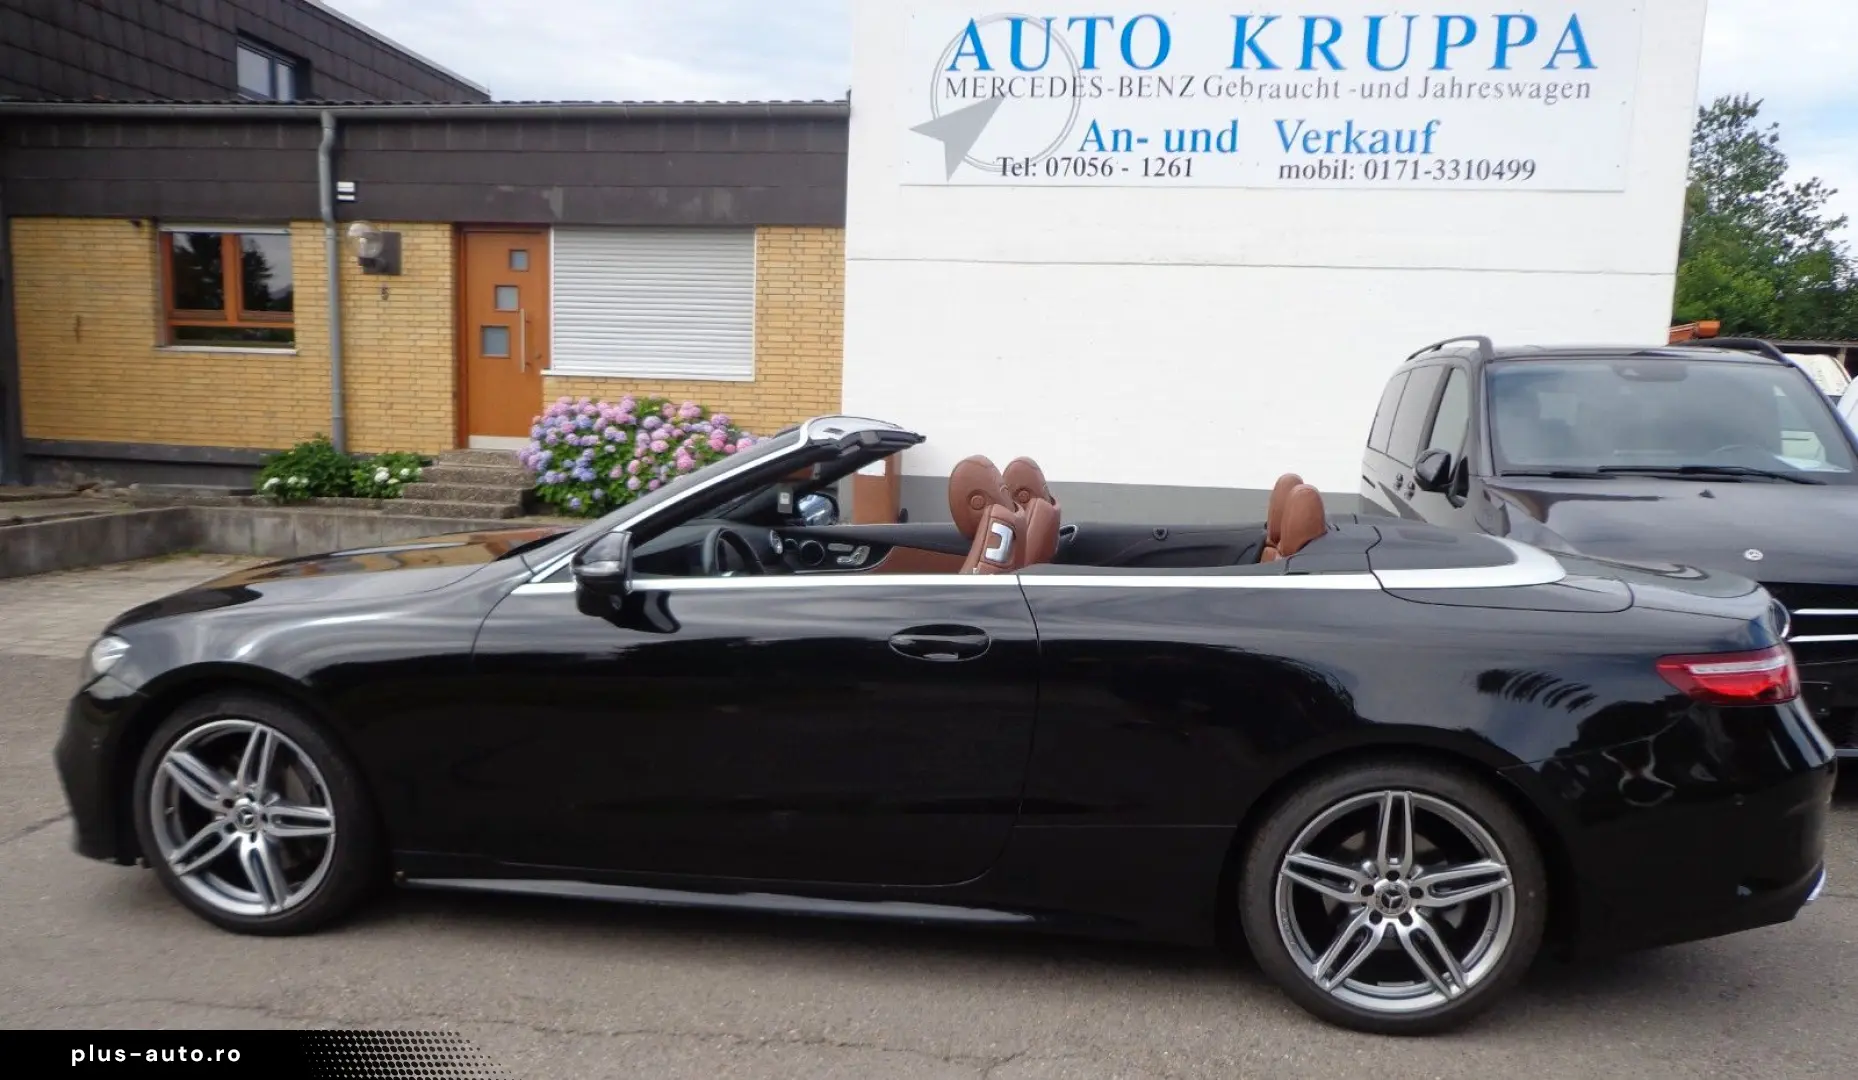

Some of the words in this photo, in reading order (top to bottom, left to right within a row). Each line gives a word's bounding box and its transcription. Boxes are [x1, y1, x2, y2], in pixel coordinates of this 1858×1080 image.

[946, 14, 1172, 71] AUTO
[1226, 13, 1599, 71] KRUPPA
[946, 75, 1196, 99] MERCEDES-BENZ
[1203, 75, 1341, 100] Gebraucht
[1349, 77, 1409, 99] -und
[1418, 76, 1592, 106] Jahreswagen
[1078, 118, 1149, 153] An-
[1163, 118, 1239, 153] und
[1274, 119, 1441, 154] Verkauf
[997, 156, 1038, 177] Tel:
[1045, 156, 1114, 178] 07056
[1141, 156, 1194, 178] 1261
[1278, 157, 1355, 181] mobil:
[1363, 158, 1537, 181] 0171-3310499
